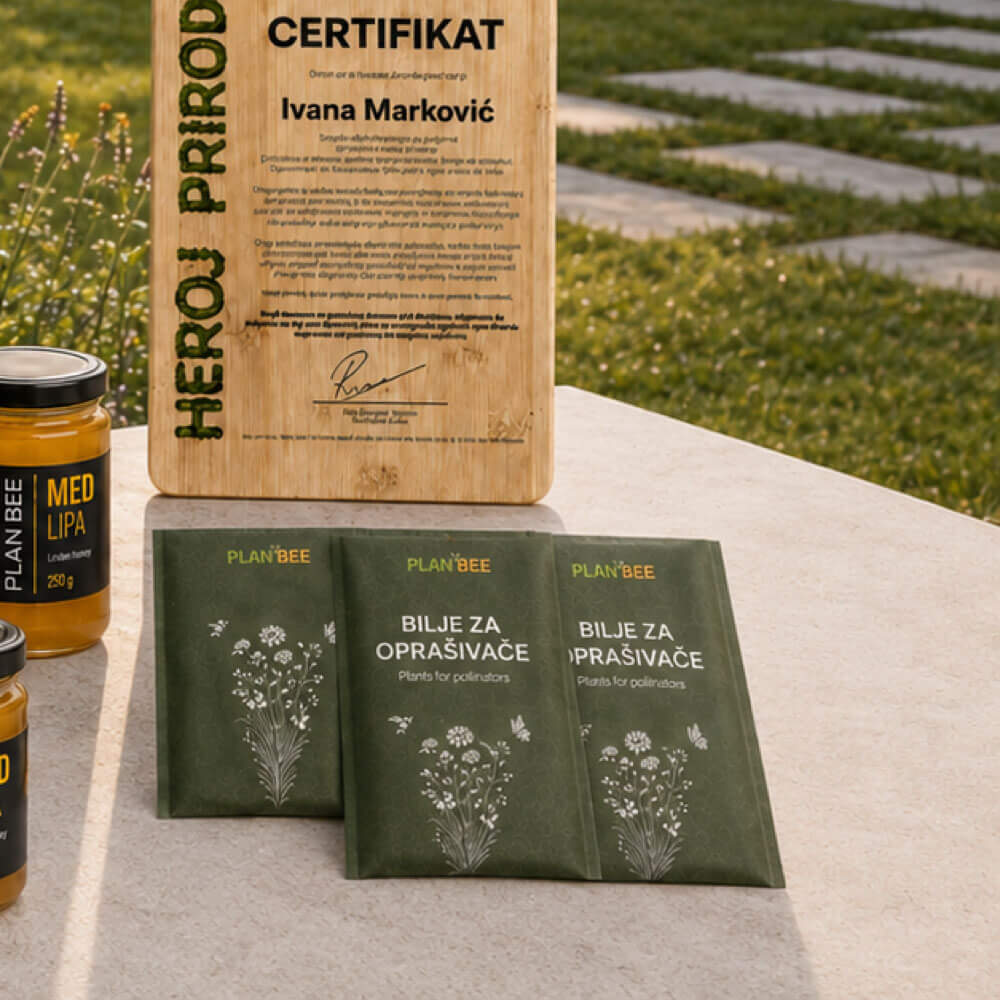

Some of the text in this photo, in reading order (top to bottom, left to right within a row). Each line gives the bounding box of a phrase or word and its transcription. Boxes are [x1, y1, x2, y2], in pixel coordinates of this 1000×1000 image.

[267, 16, 504, 51] CERTIFIKAT
[281, 96, 495, 124] Ivana Marković
[174, 247, 226, 440] HEROJ
[47, 472, 95, 508] MED
[4, 478, 23, 591] PLAN BEE
[47, 509, 86, 541] LIPA
[401, 615, 501, 634] BILJE ZA
[579, 621, 675, 641] BILJE ZA
[375, 637, 530, 662] OPRAŠIVAČE
[569, 643, 705, 669] PRAŠIVAČE
[398, 670, 510, 684] Plants for pollinators
[612, 676, 628, 688] for
